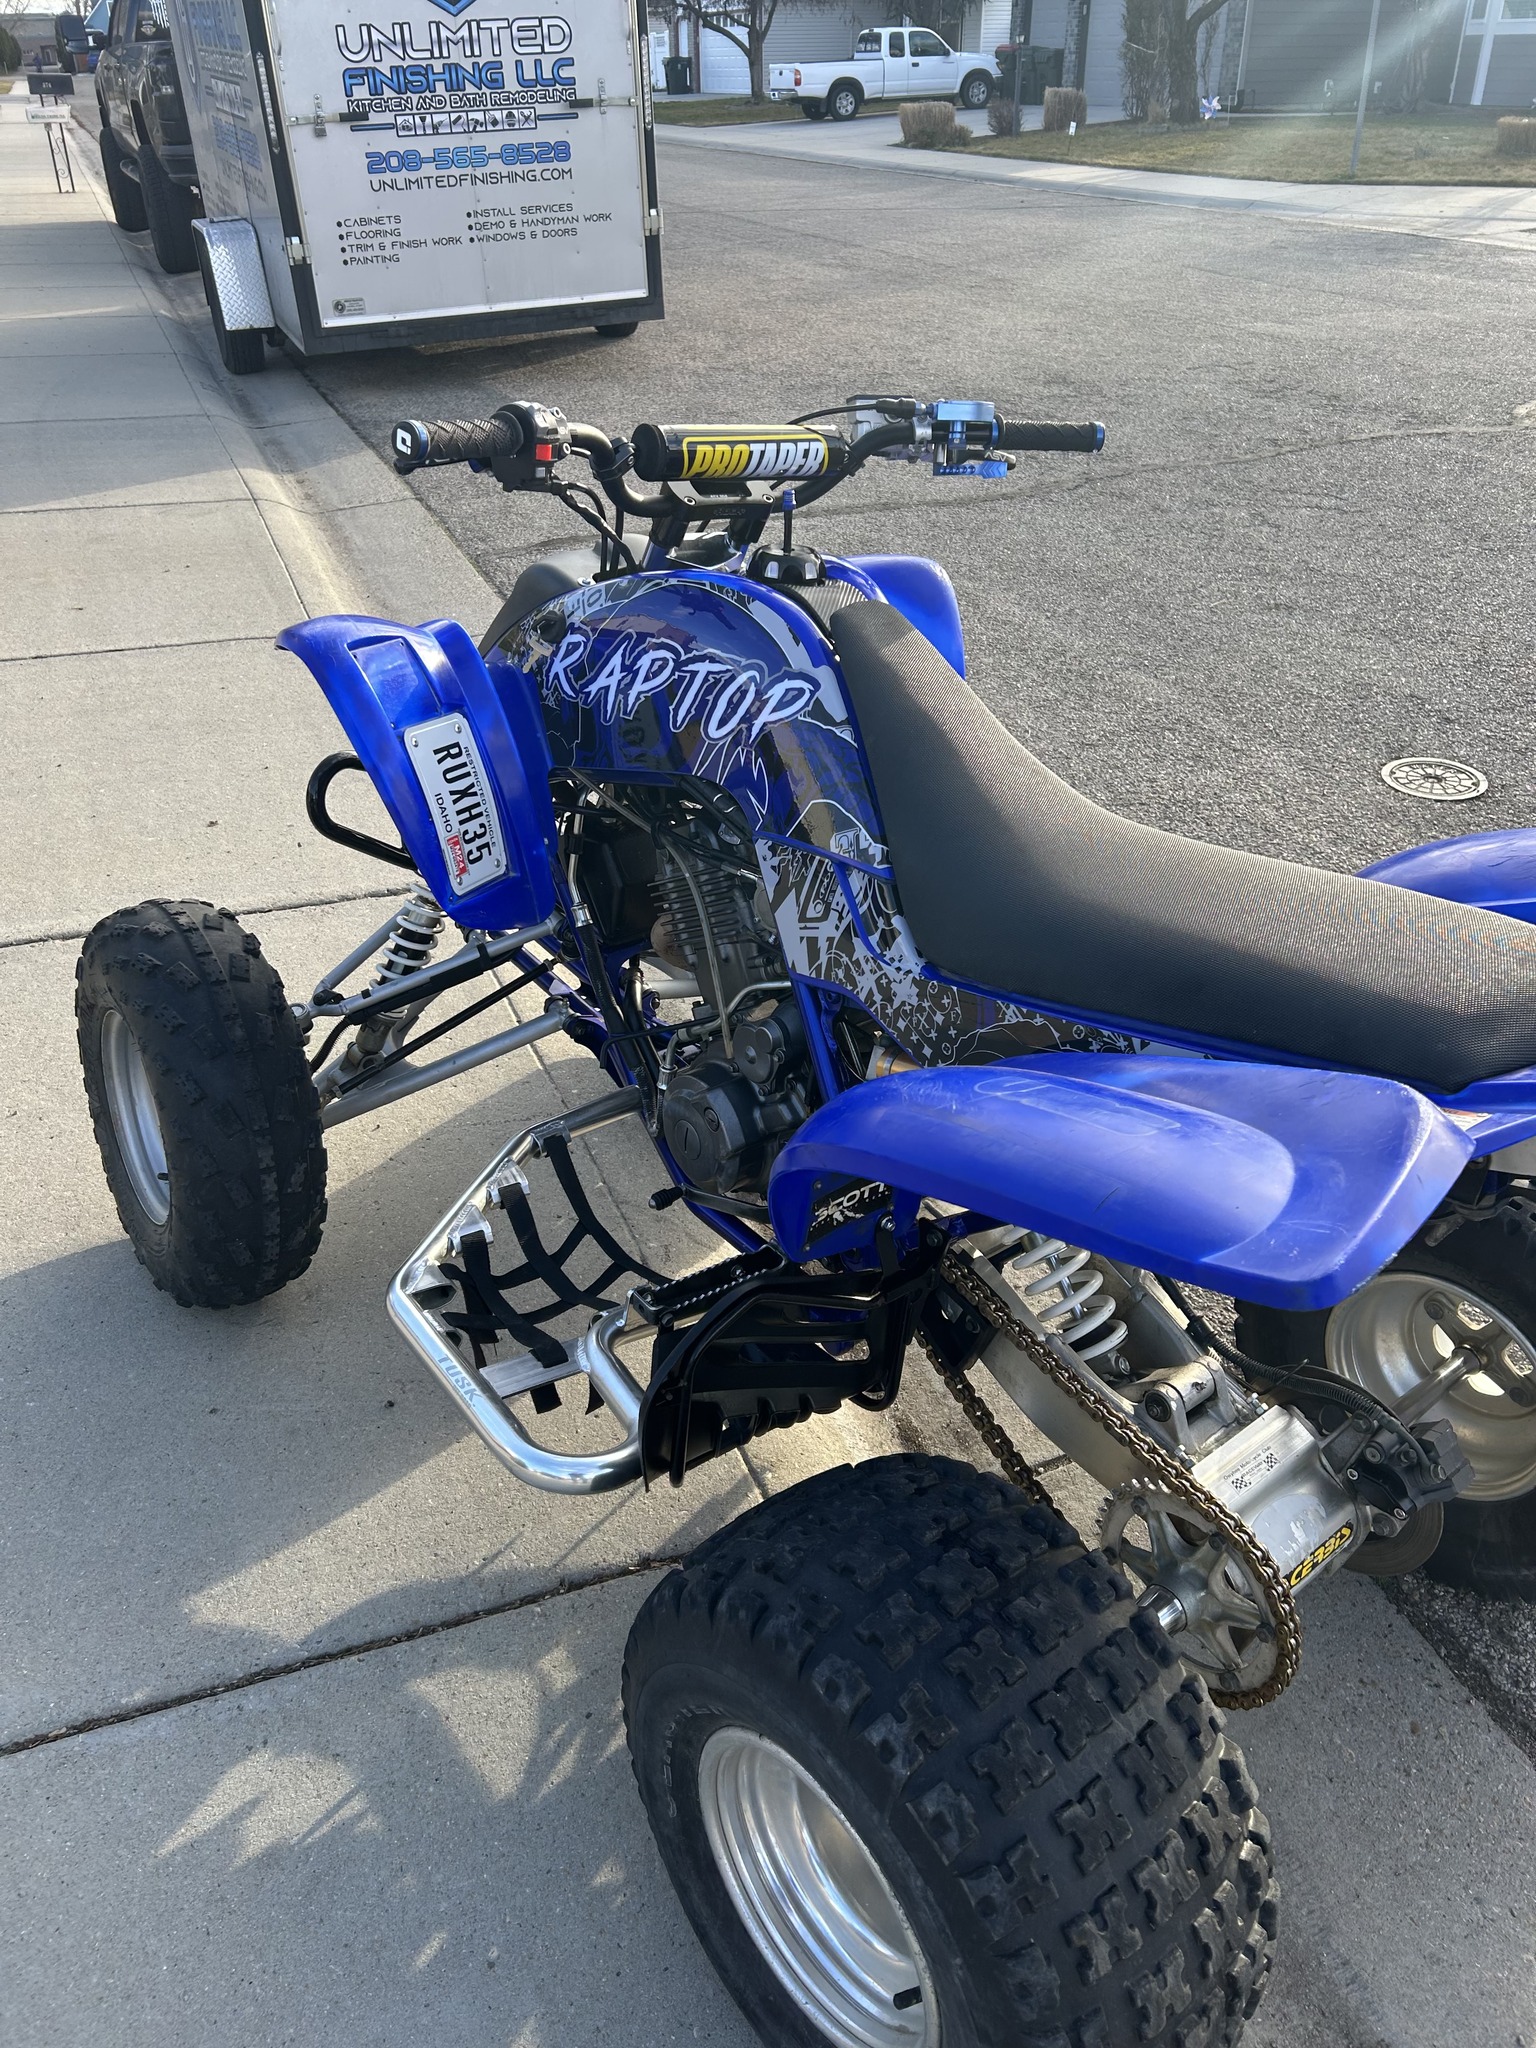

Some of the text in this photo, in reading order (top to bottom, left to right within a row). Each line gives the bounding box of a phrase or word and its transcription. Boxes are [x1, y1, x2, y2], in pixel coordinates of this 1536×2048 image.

[335, 15, 573, 63] UNLIMITED
[342, 57, 576, 97] FINISHING LLC
[347, 88, 576, 114] KITCHEN AND BATH REMODELING
[365, 140, 572, 174] 208-565-8528
[369, 168, 573, 192] UNLIMITEDFINISHING.COM
[343, 215, 402, 228] CABINETS
[472, 203, 574, 218] INSTALL SERVICES
[474, 212, 613, 231] DEMO & HANDYMAN WORK
[345, 228, 401, 240] FLOORING
[348, 236, 463, 253] TRIM & FINISH WORK
[476, 227, 578, 243] WINDOWS & DOORS
[349, 254, 400, 266] PAINTING
[432, 741, 492, 865] RUXH35
[463, 746, 496, 848] RESTRICTED VEHICLE
[434, 793, 453, 833] IDAHO
[437, 1353, 483, 1402] TUSK
